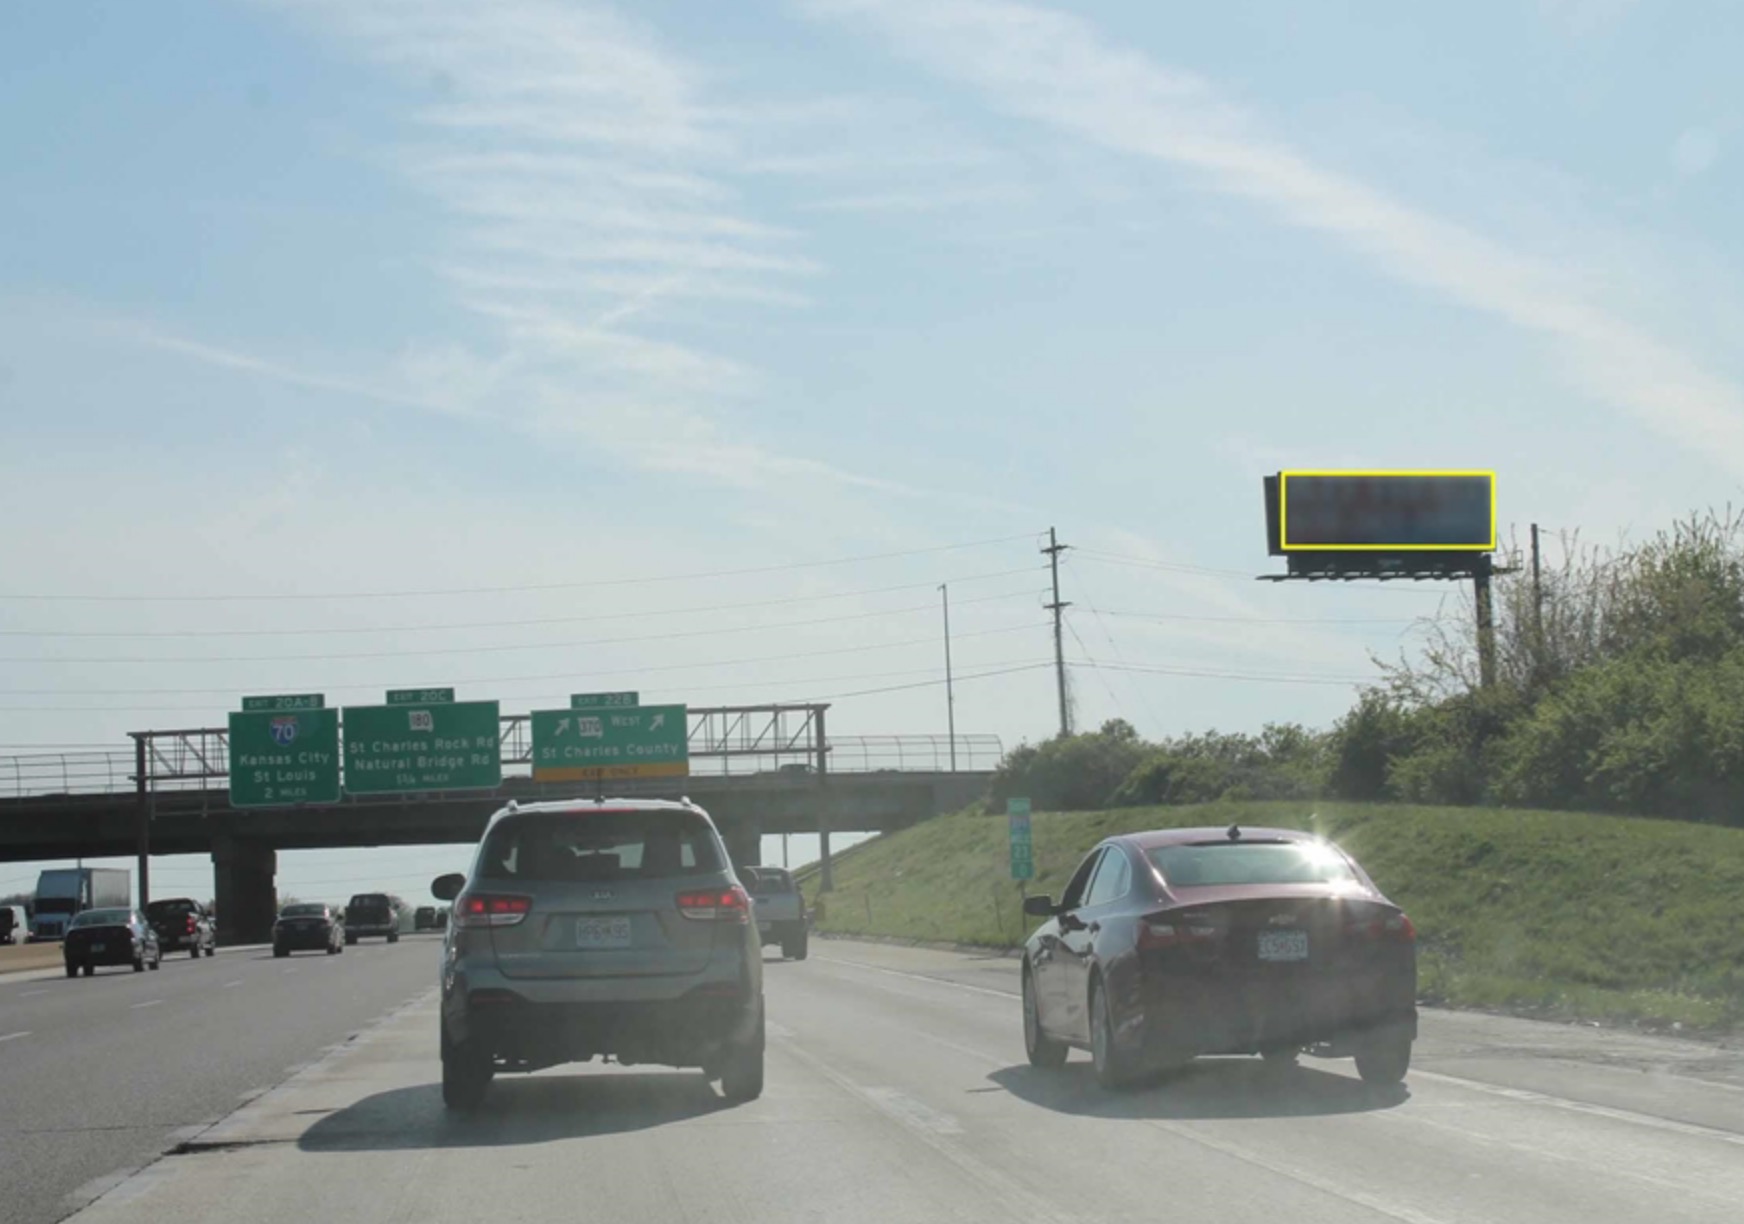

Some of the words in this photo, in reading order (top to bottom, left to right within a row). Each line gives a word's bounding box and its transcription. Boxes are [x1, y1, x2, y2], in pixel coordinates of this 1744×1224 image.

[420, 691, 447, 700] 20C
[611, 716, 641, 726] WEST
[272, 724, 294, 740] 70
[350, 742, 365, 753] St
[372, 741, 428, 753] Charles
[435, 738, 469, 750] Rock
[476, 736, 494, 748] Rd
[542, 748, 556, 759] St
[564, 746, 620, 758] Charles
[626, 744, 679, 755] County
[240, 754, 292, 766] Kansas
[298, 751, 329, 765] City
[354, 758, 411, 770] Natural
[417, 756, 464, 769] Bridge
[471, 753, 490, 765] Rd
[254, 771, 270, 783] St
[276, 770, 316, 782] Louis
[265, 787, 273, 798] 2
